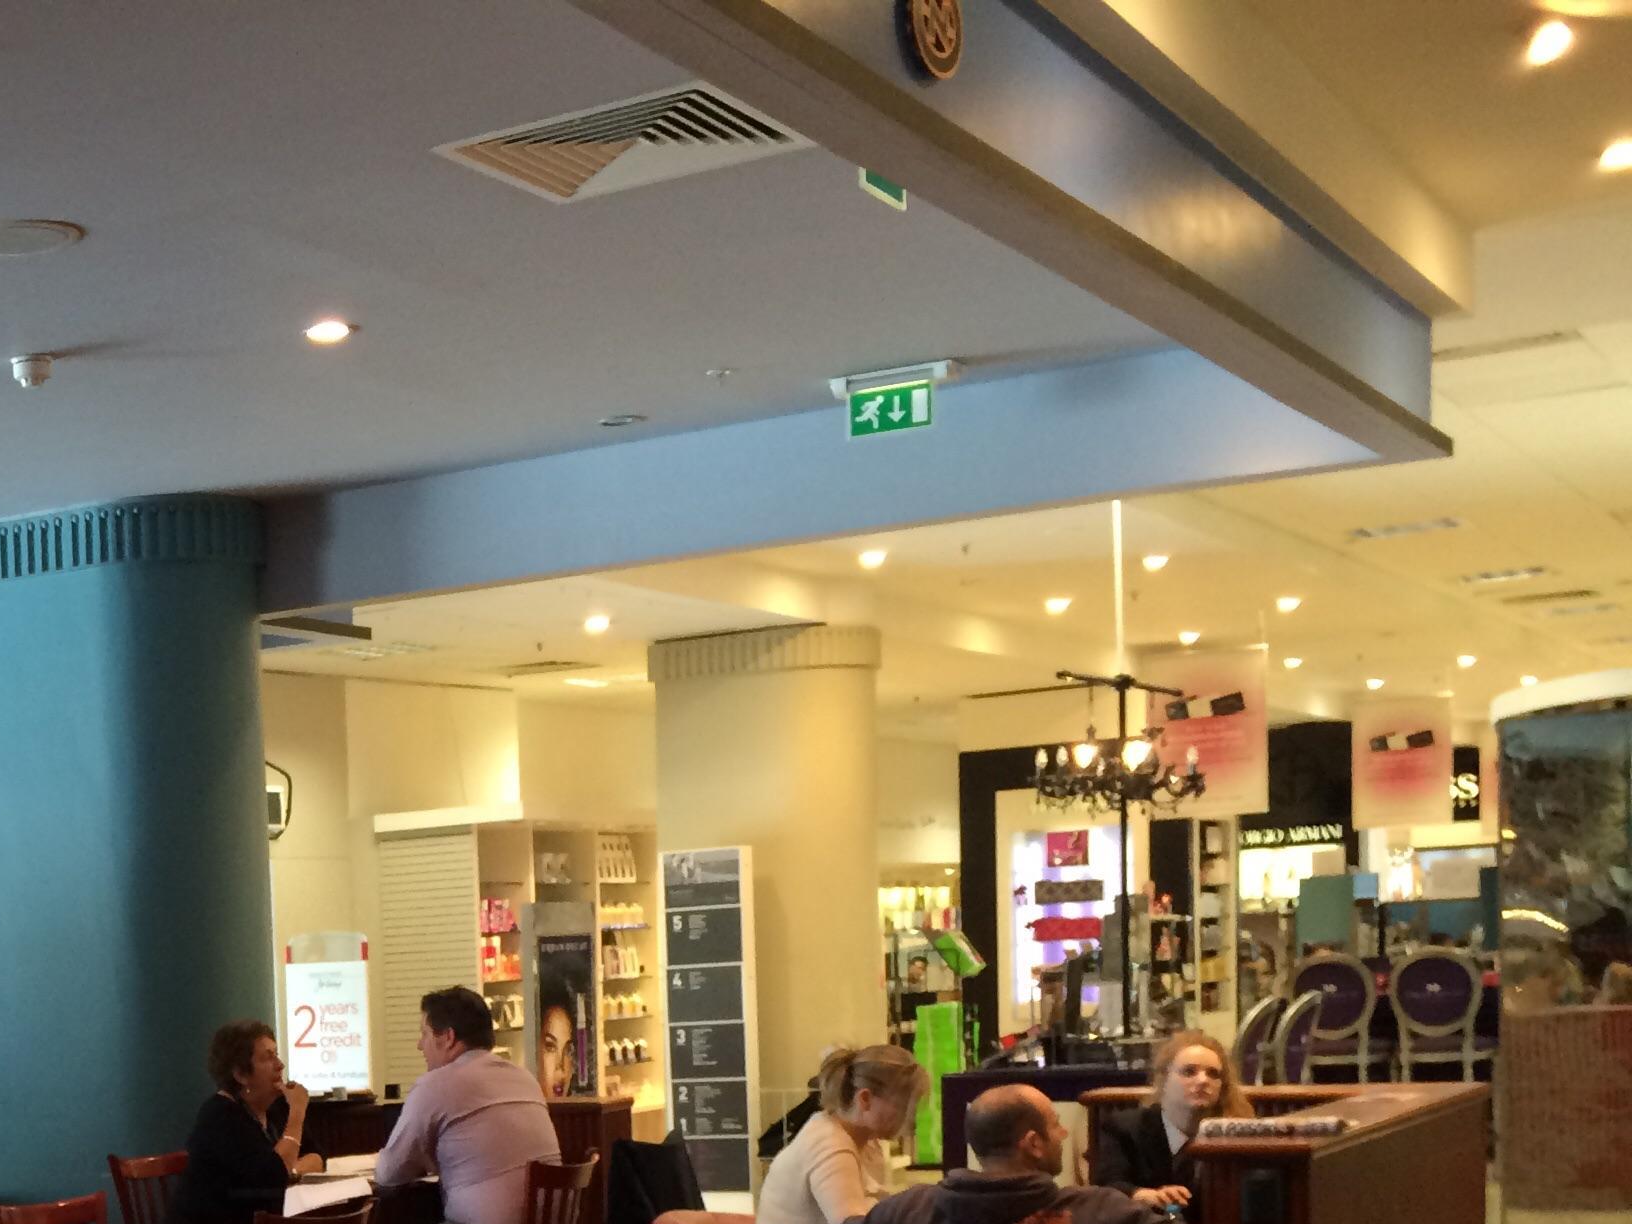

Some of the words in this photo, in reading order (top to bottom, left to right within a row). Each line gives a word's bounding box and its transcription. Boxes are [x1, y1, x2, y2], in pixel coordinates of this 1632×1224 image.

[1286, 823, 1344, 842] ARMANI
[294, 1004, 317, 1048] 2
[319, 1001, 359, 1017] years
[320, 1016, 348, 1033] free
[320, 1033, 362, 1048] credit
